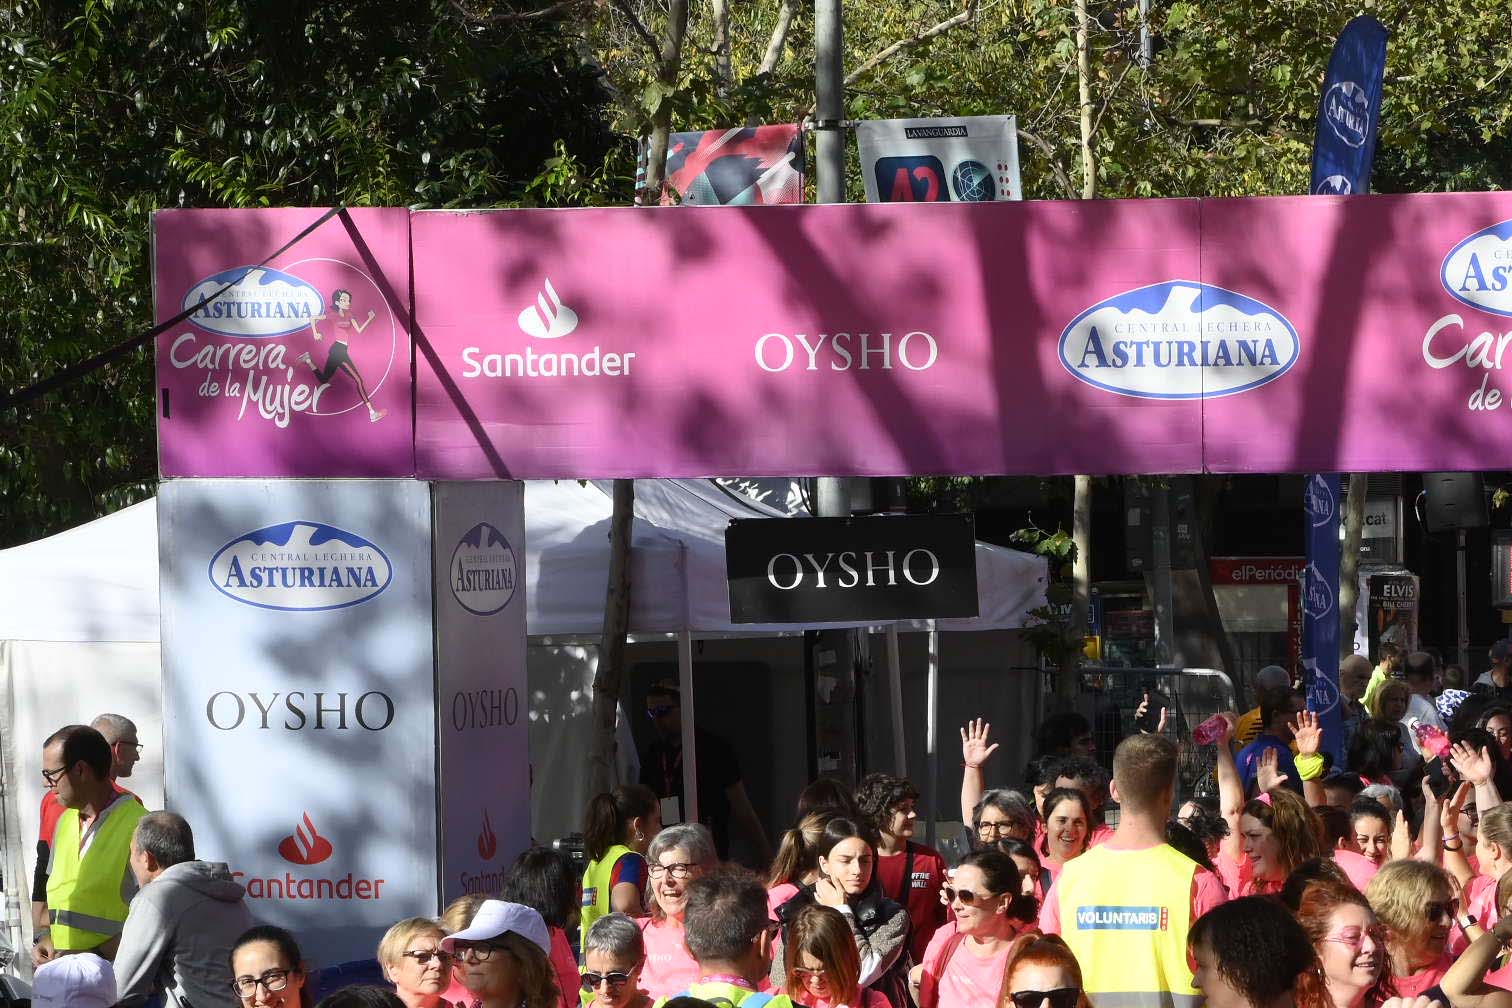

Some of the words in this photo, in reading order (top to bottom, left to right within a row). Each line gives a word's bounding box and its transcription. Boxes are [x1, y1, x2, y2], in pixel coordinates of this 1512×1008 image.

[193, 291, 313, 319] ASTURIANA
[1114, 322, 1188, 336] CENTRAL
[1198, 320, 1273, 334] LECHERA
[170, 333, 288, 370] Carrera
[462, 346, 636, 378] Santander
[755, 331, 939, 372] OYSHO
[1077, 326, 1281, 368] ASTURIANA
[199, 371, 220, 397] de
[225, 371, 241, 397] la
[238, 367, 332, 429] Mujer
[1468, 372, 1503, 412] de
[223, 555, 379, 590] ASTURIANA
[250, 552, 310, 562] CENTRAL
[314, 551, 373, 562] LECHERA
[767, 548, 940, 590] OYSHO
[454, 560, 513, 592] ASTURIANA
[1231, 564, 1306, 583] elPeriódi
[1383, 584, 1415, 598] ELVIS
[206, 691, 396, 731] OYSHO
[452, 687, 519, 732] OYSHO
[460, 866, 506, 895] Santand
[1077, 911, 1158, 926] VOLUNTARIS
